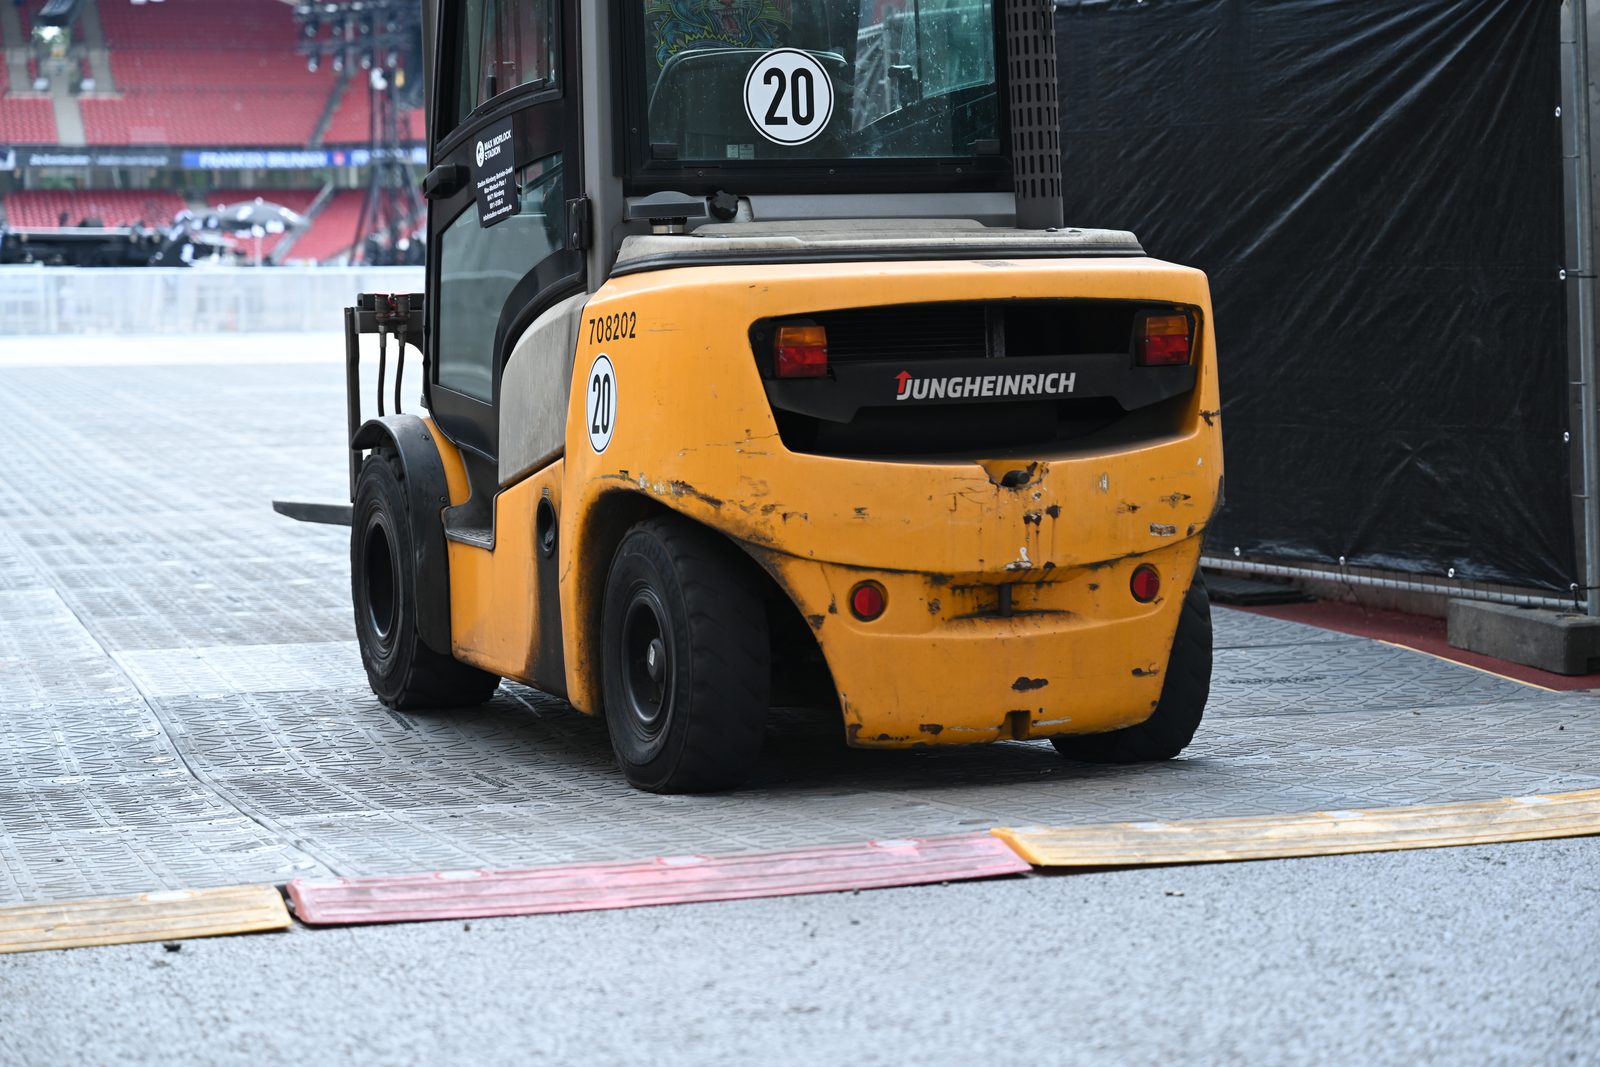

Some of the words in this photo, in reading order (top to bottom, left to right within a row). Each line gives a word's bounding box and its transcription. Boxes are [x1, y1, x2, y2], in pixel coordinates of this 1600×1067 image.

[763, 67, 815, 126] 20
[484, 139, 493, 151] MAX
[484, 145, 501, 160] STADION
[589, 311, 637, 345] 708202
[895, 371, 1077, 401] JUNGHEINRICH
[592, 373, 611, 434] 20
